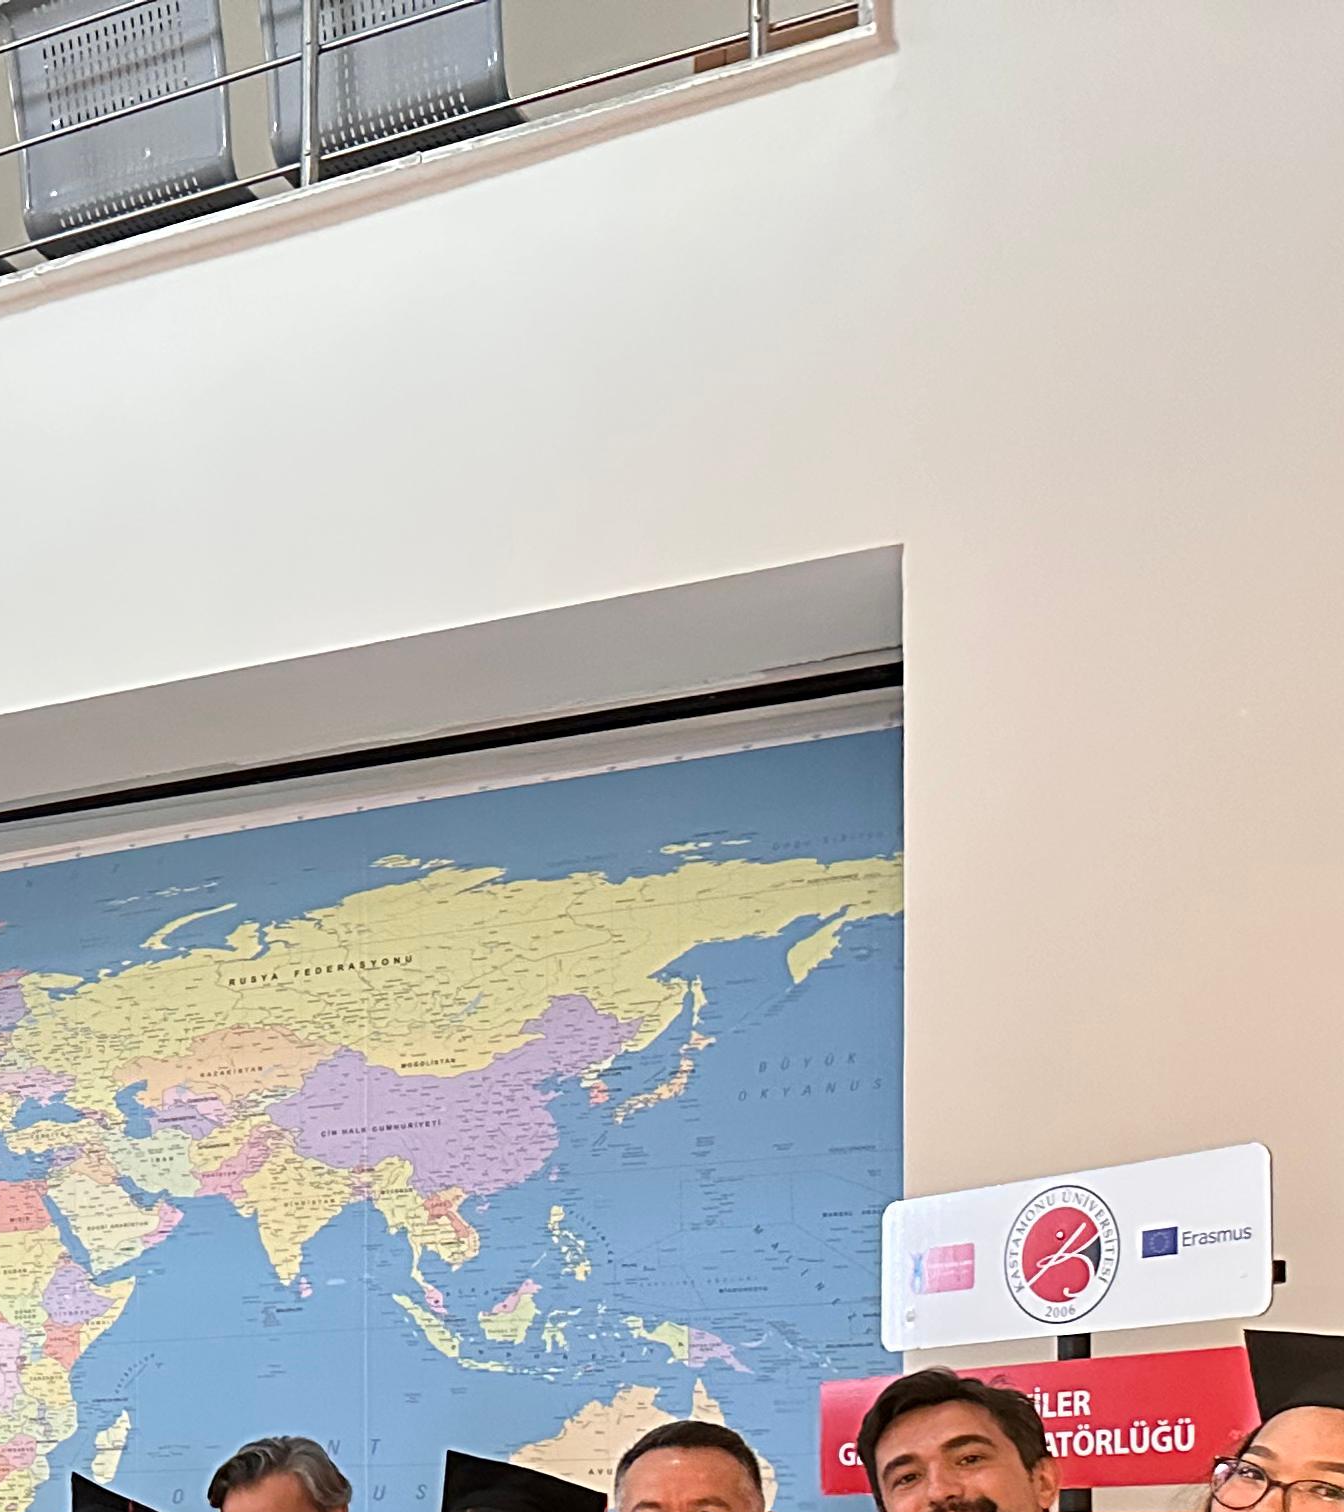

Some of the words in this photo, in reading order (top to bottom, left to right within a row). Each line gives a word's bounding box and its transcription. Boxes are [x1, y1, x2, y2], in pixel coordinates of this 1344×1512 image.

[228, 972, 279, 987] RUSYA
[293, 954, 413, 978] FEDERASYONU
[1011, 1193, 1057, 1294] KASTAMONU
[1061, 1188, 1116, 1284] ÜNİVERSİTESİ
[1181, 1225, 1253, 1248] Erasmus
[1044, 1304, 1076, 1319] 2006
[1028, 1386, 1092, 1419] İLER
[1045, 1417, 1195, 1458] ATÖRLÜĞÜ
